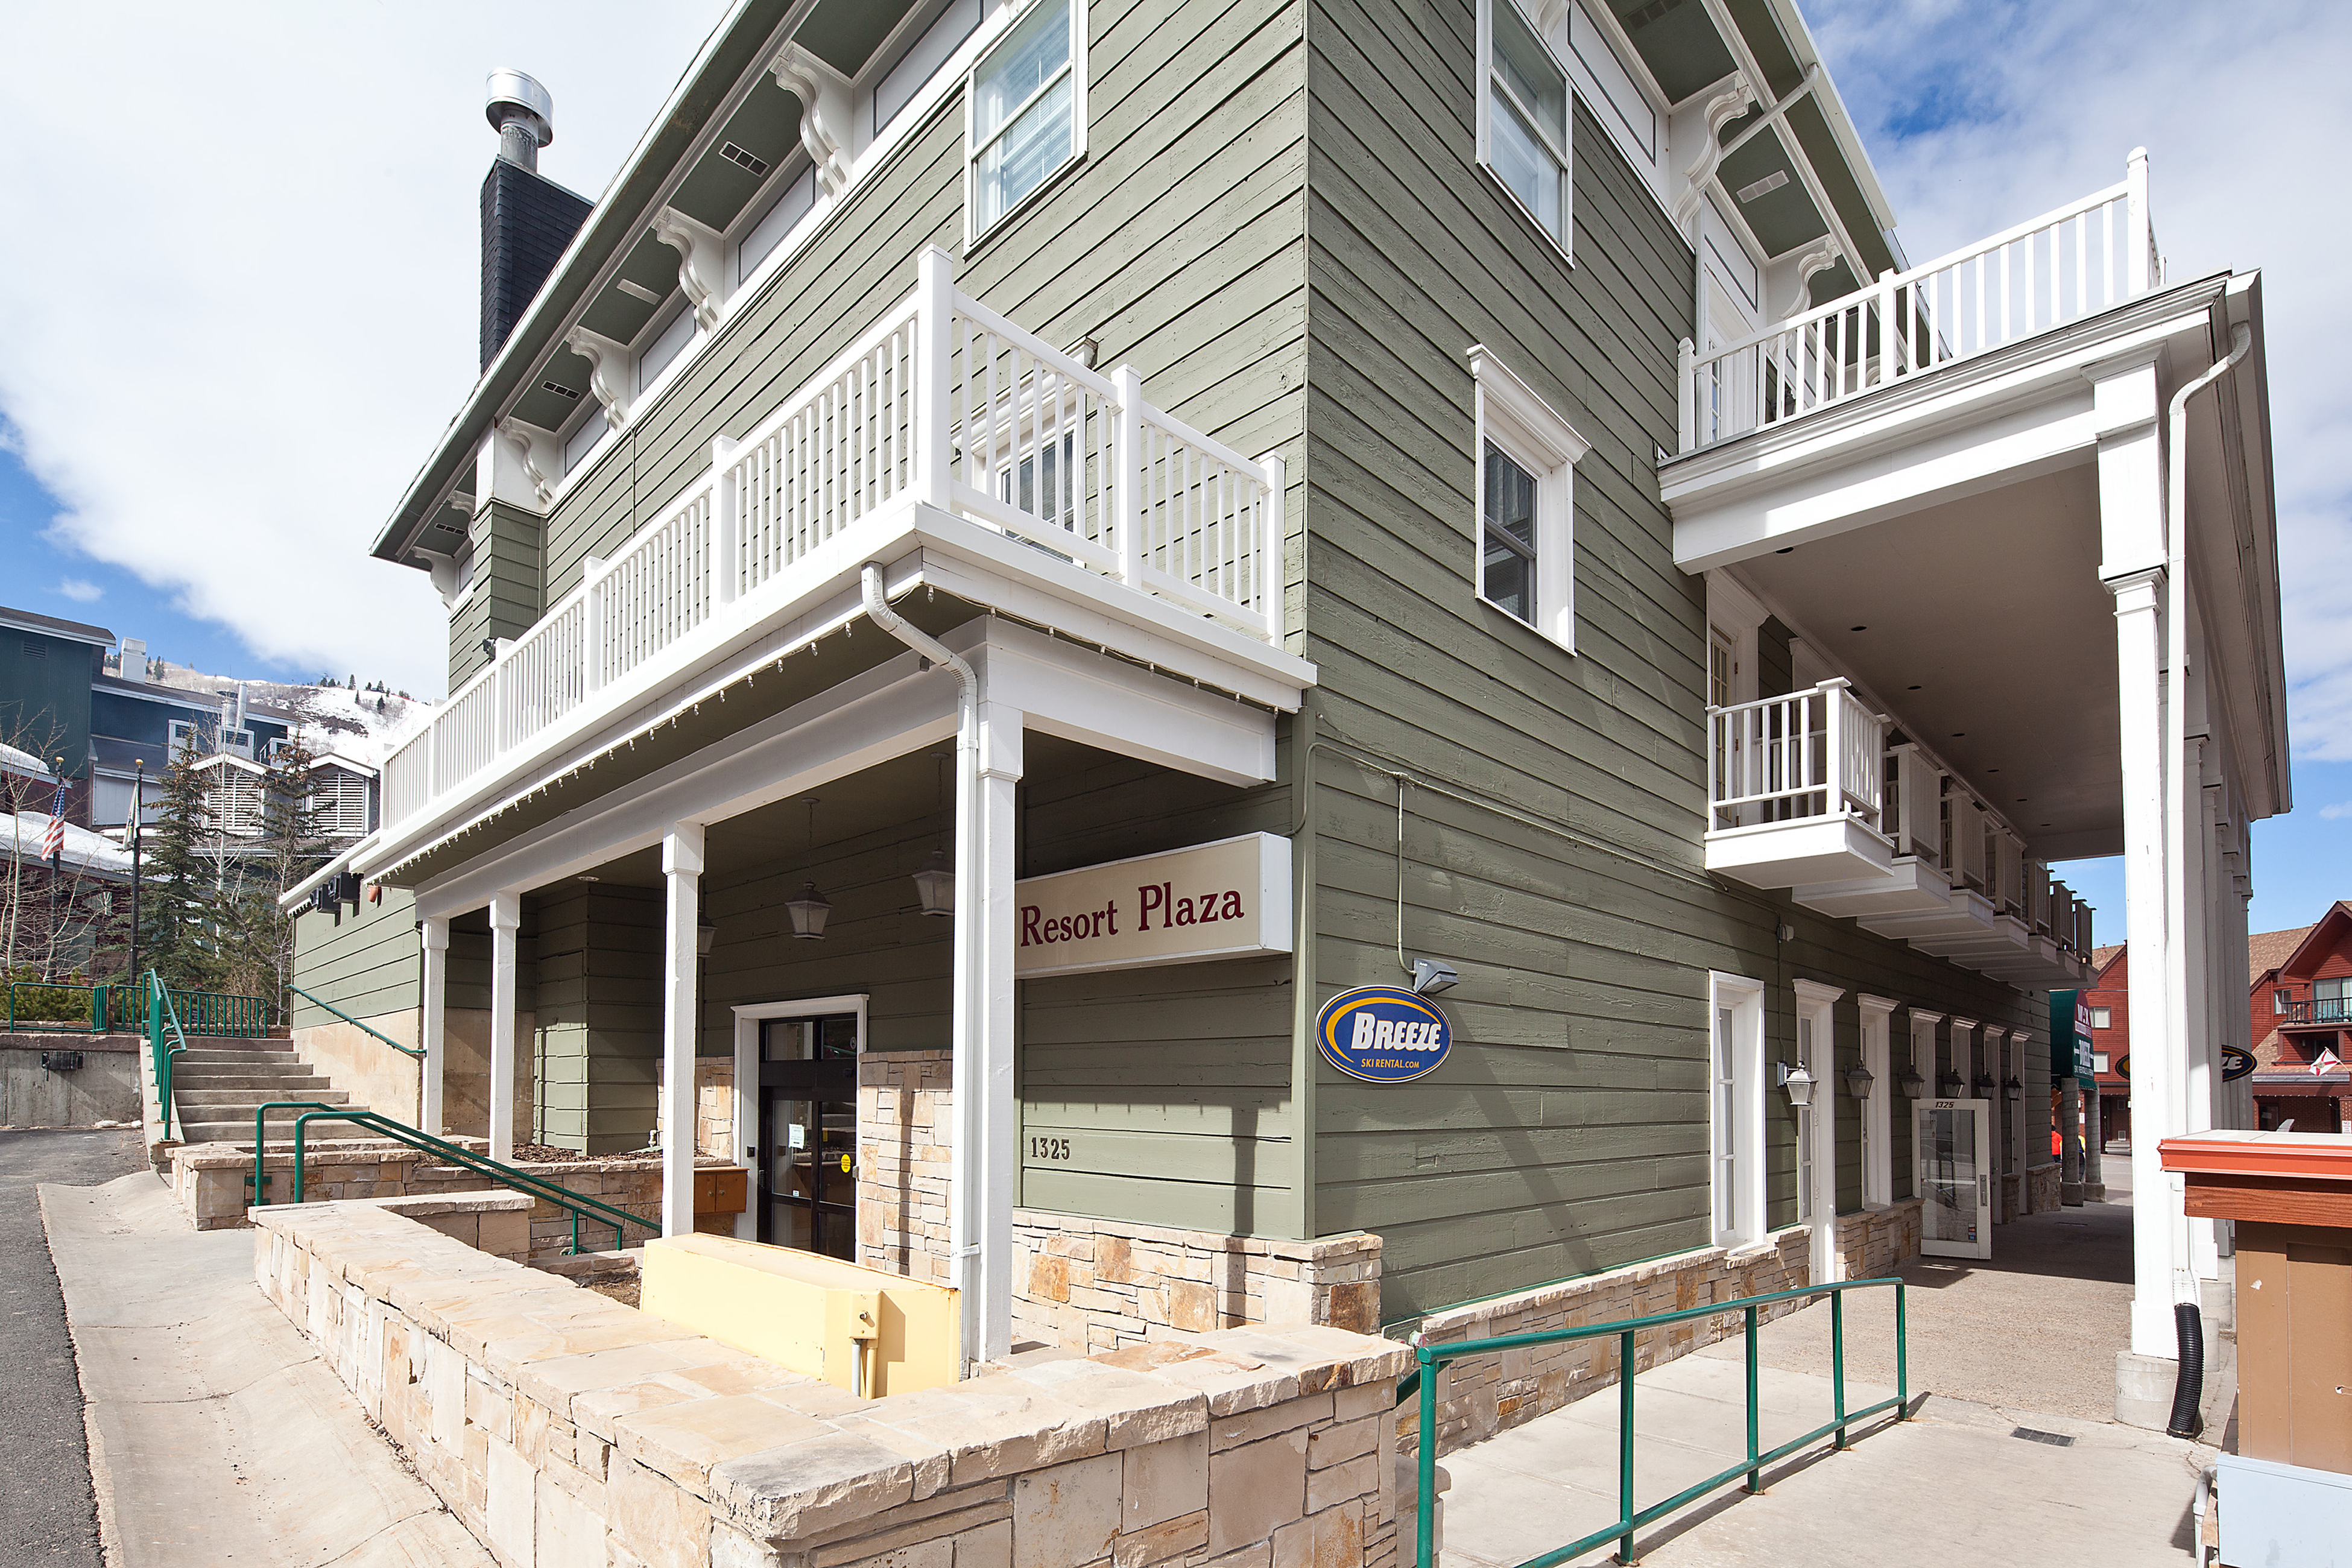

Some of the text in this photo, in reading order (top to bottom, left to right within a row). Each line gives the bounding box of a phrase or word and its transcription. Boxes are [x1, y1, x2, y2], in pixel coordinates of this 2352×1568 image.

[1020, 882, 1245, 947] Resort Plaza
[1351, 1012, 1442, 1051] BREEZE
[1031, 1137, 1070, 1160] 1325
